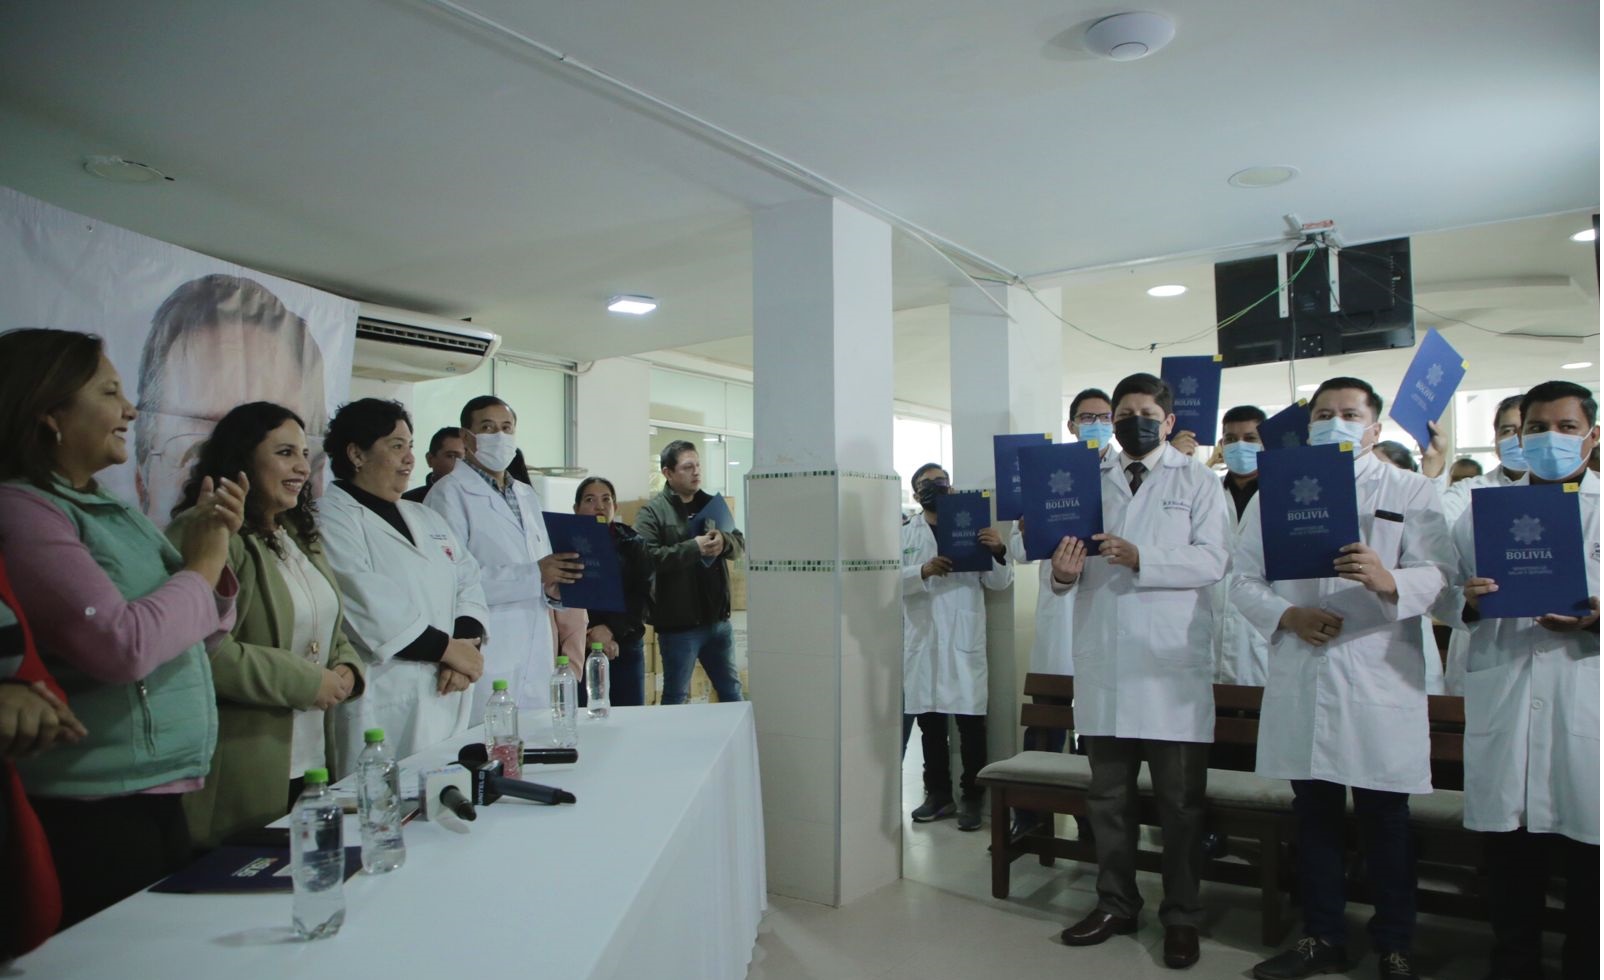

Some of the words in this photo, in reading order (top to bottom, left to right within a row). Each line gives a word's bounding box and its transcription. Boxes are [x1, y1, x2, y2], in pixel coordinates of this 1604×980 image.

[1045, 498, 1080, 510] BOLIVIA
[1288, 510, 1329, 521] BOLIVIA
[1505, 550, 1553, 560] BOLIVIA
